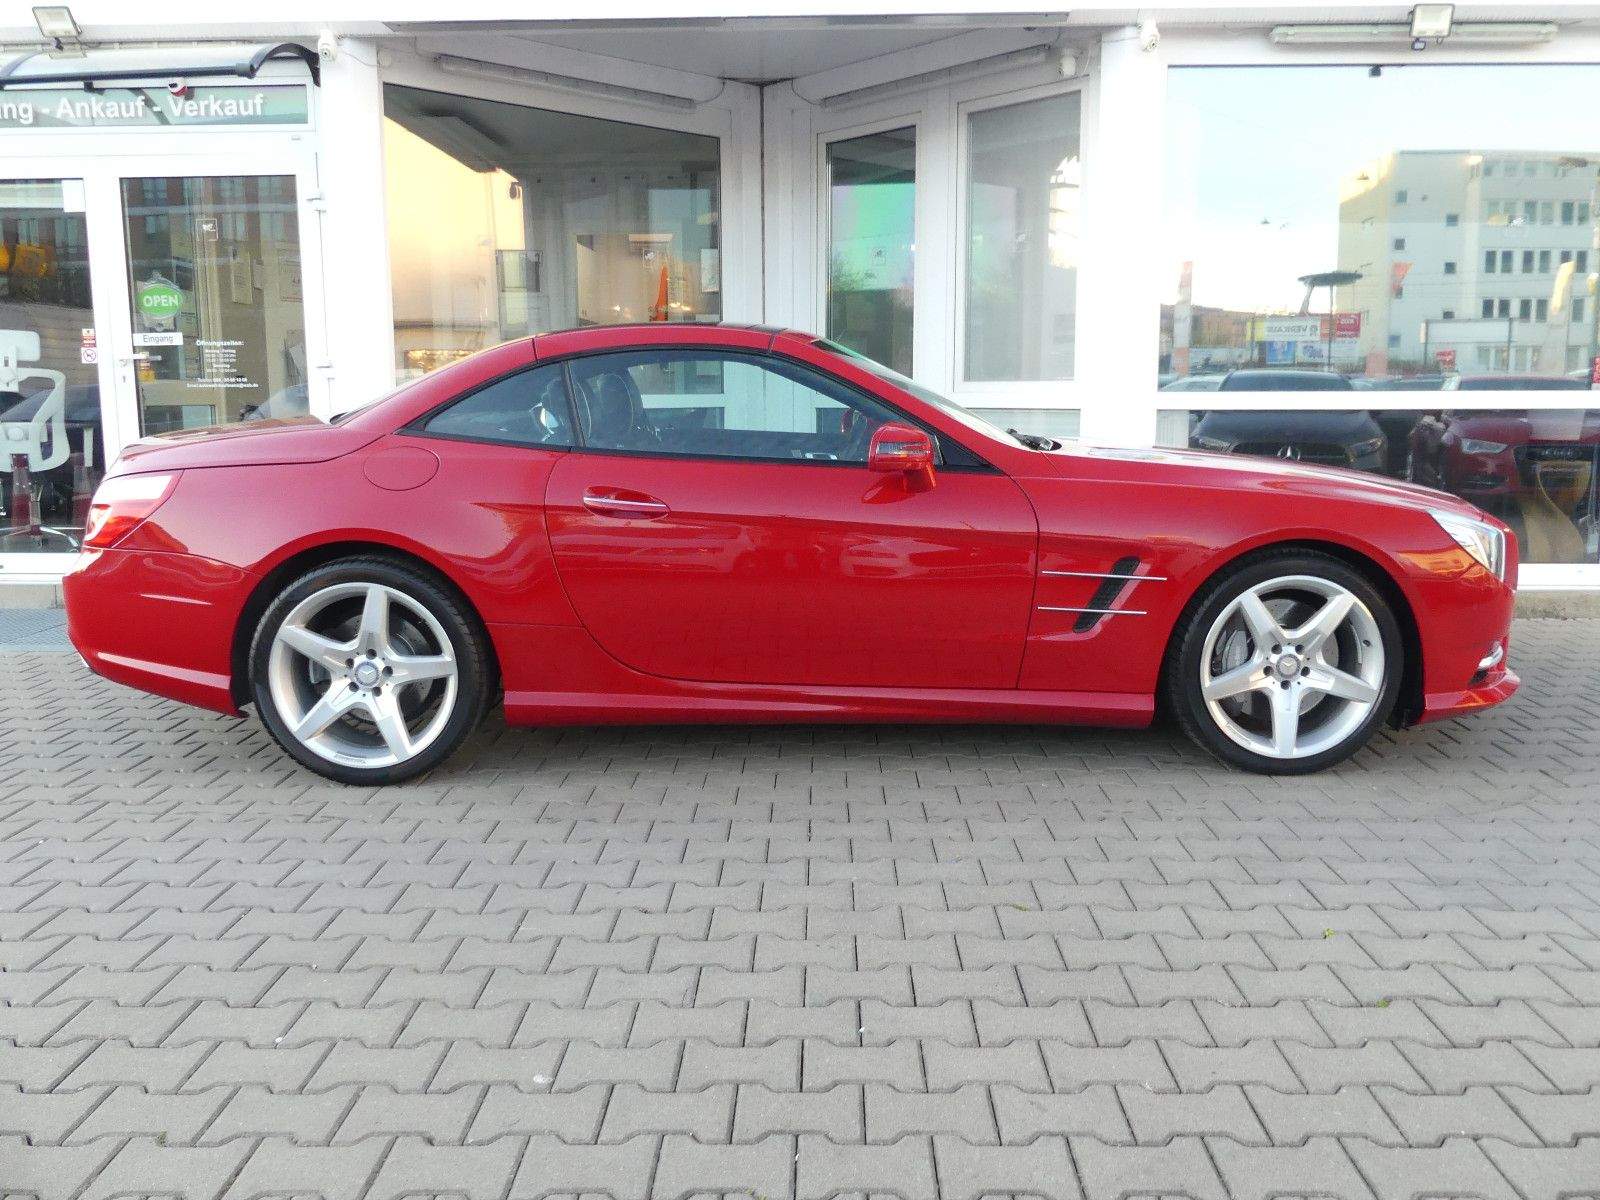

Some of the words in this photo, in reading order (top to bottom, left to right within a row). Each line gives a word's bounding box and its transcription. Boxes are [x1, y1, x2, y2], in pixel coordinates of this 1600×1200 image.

[0, 102, 33, 125] ng
[56, 95, 146, 119] Ankauf
[167, 93, 264, 117] Verkauf
[143, 294, 179, 307] OPEN
[142, 334, 175, 344] Eingang
